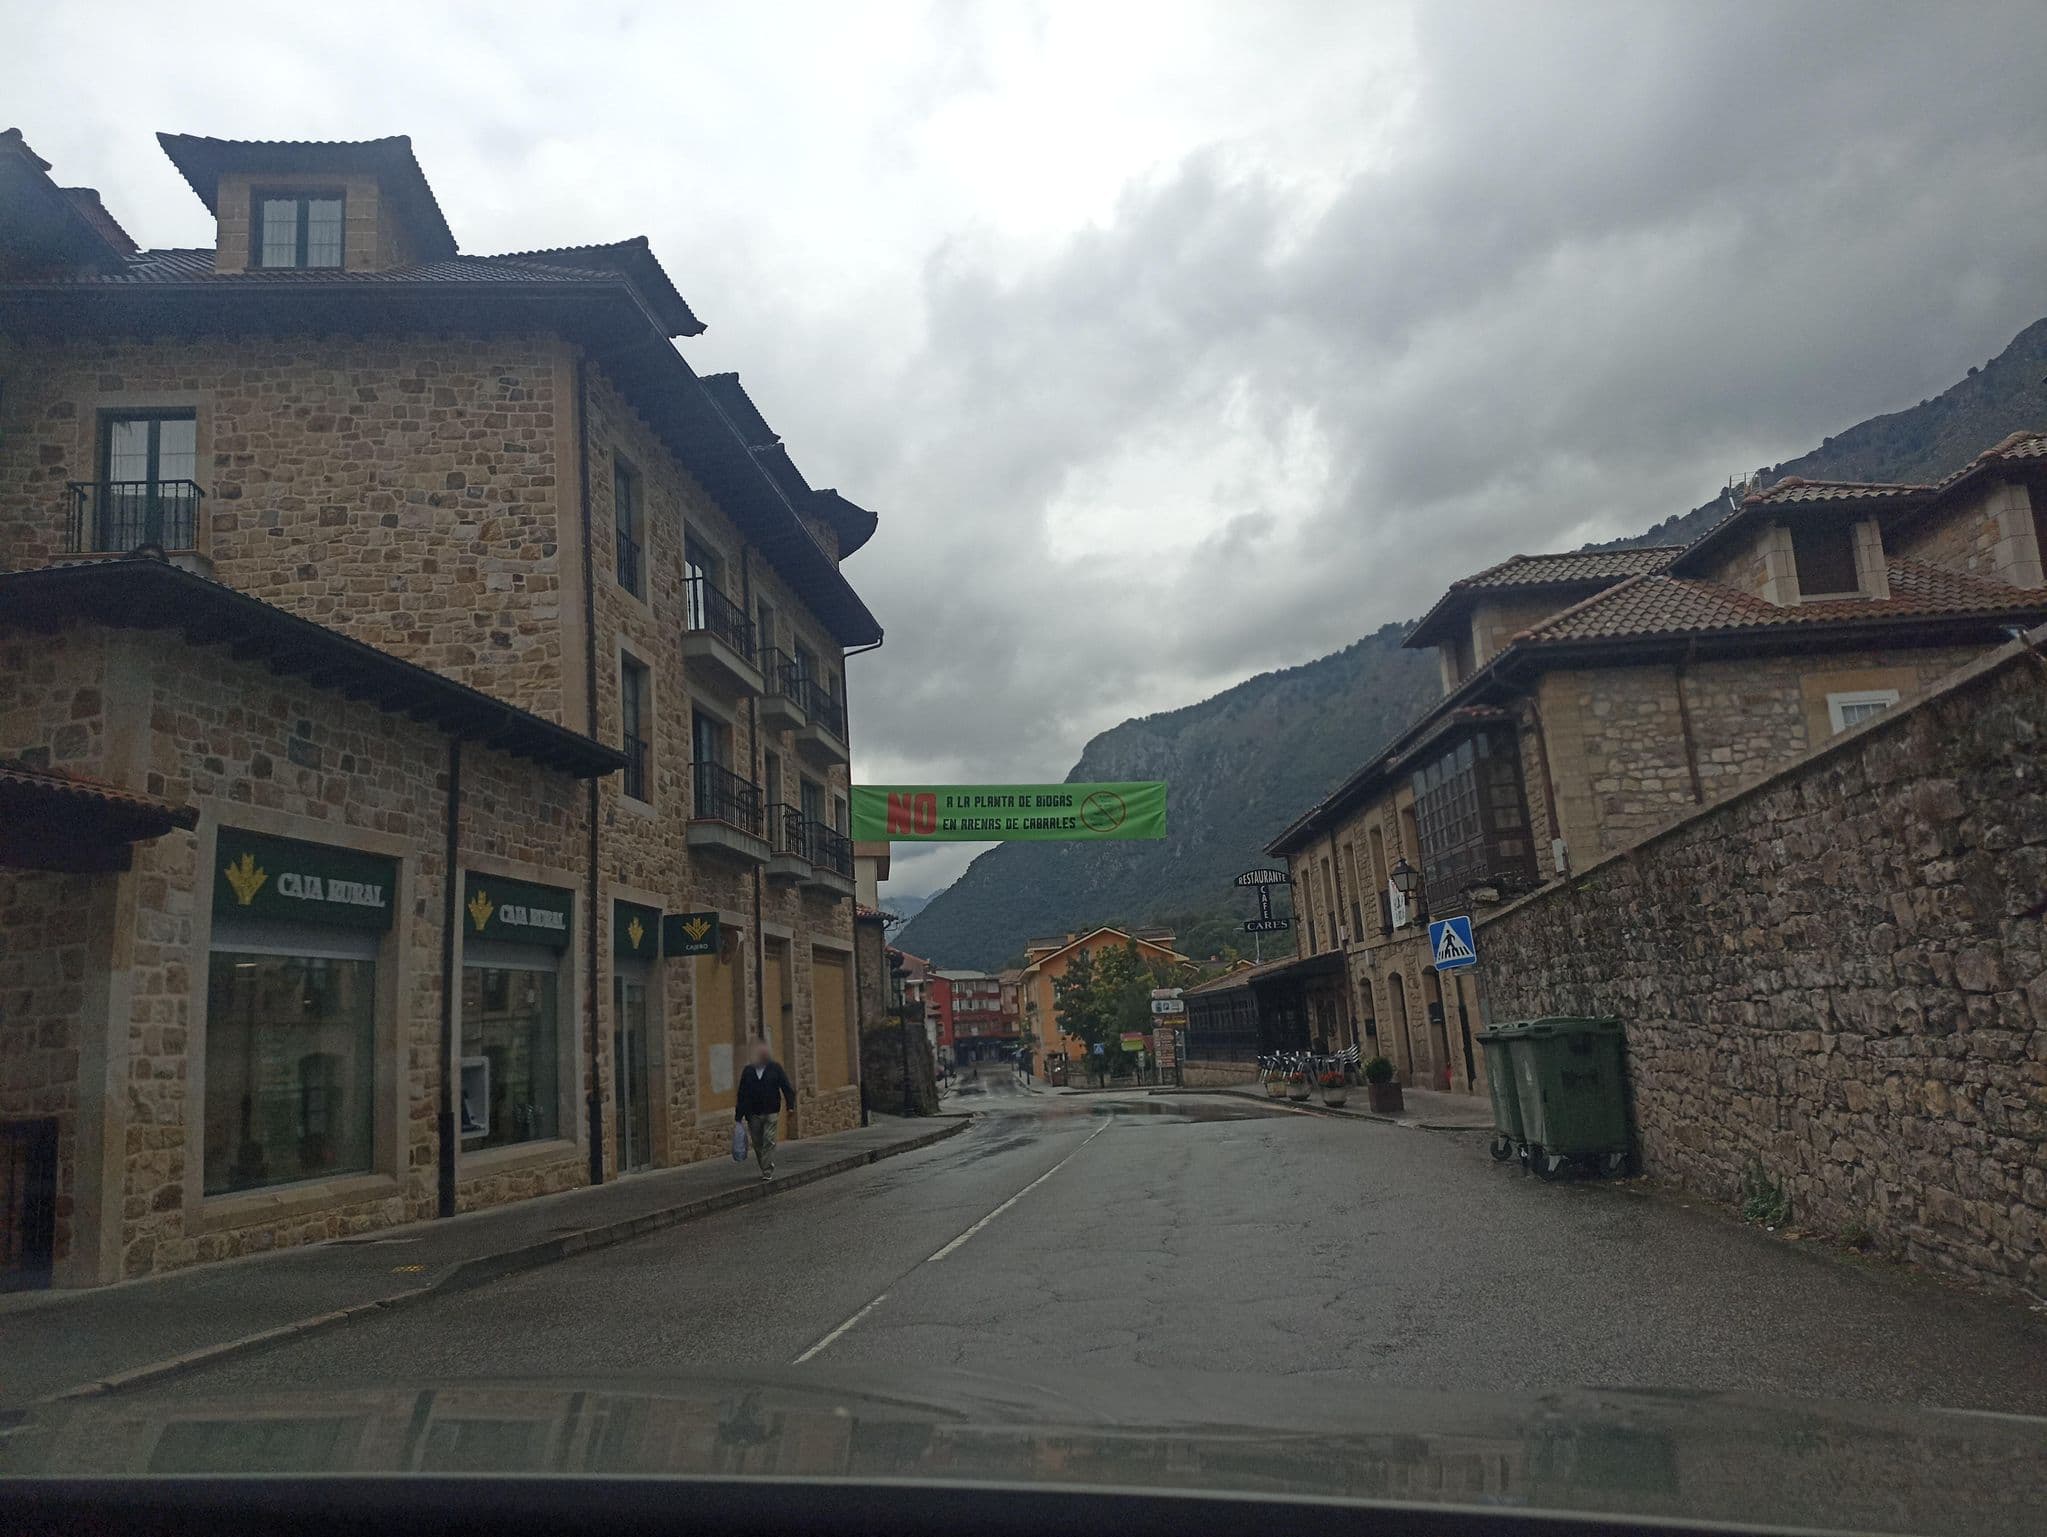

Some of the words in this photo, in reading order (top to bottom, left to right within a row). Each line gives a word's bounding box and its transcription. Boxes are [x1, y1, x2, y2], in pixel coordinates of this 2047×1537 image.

[946, 796, 953, 808] A
[957, 796, 970, 808] LA
[974, 796, 1014, 808] PLANTA
[1018, 795, 1031, 807] DE
[887, 792, 937, 835] NO
[943, 818, 957, 831] EN
[961, 818, 1001, 830] ARENAS
[1006, 818, 1019, 830] DE
[1023, 816, 1076, 830] CABRALES
[1238, 870, 1287, 885] RESTAURANTE
[277, 872, 325, 900] CAJA
[326, 879, 386, 908] RURAL
[1260, 886, 1269, 918] CAFE
[499, 904, 529, 927] CAJA
[529, 908, 566, 930] RURAL
[1247, 920, 1288, 931] CARES
